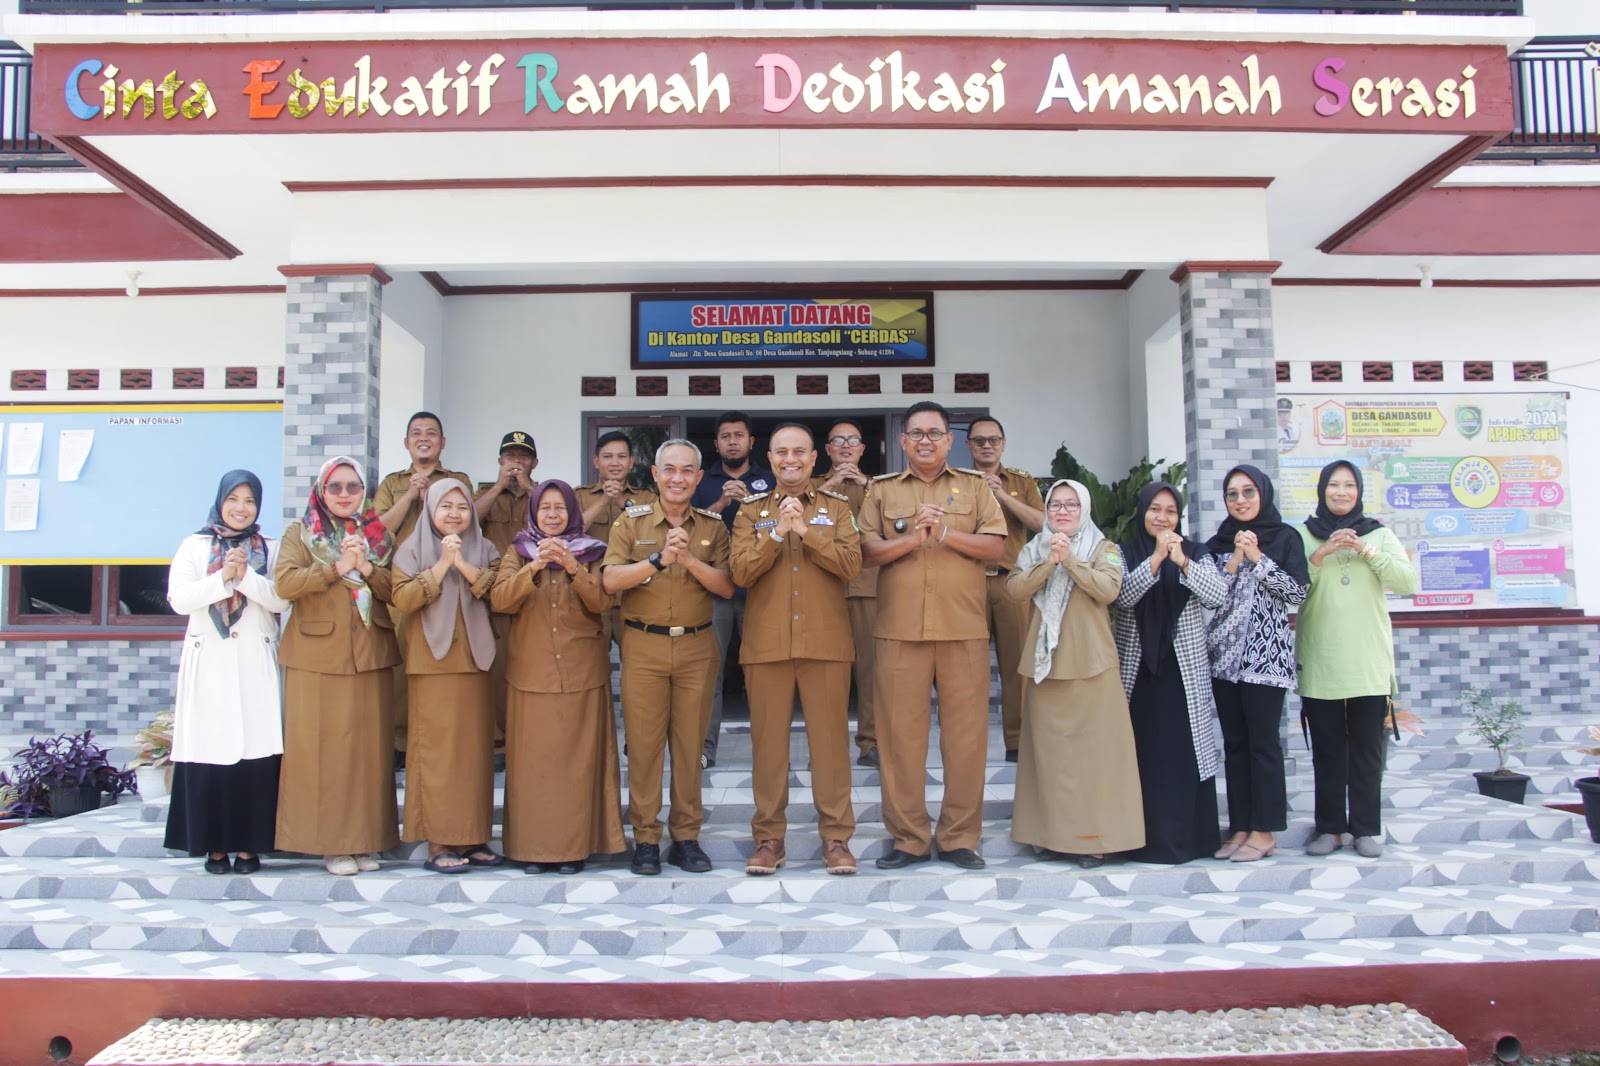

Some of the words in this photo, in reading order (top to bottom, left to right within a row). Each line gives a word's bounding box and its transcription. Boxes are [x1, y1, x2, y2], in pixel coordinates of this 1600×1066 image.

[64, 58, 218, 120] Cinta
[241, 53, 506, 119] Edukatif
[516, 52, 731, 115] Ramah
[755, 50, 1007, 114] Dedikasi
[1035, 53, 1282, 116] Amanah
[1313, 56, 1478, 119] Serasi
[691, 304, 787, 327] SELAMAT
[790, 303, 871, 327] DATANG
[648, 331, 665, 346] Di
[667, 330, 718, 346] Kantor
[722, 330, 760, 345] Desa
[763, 329, 841, 344] Gandasoli
[718, 349, 745, 357] Gandasoli
[817, 348, 854, 357] Tanjungsiang
[857, 349, 877, 357] Subang
[109, 417, 134, 425] PAPAN
[138, 417, 182, 425] INFORMASI
[1352, 411, 1376, 421] DESA
[1378, 411, 1432, 421] GANDASOLI
[1525, 410, 1557, 426] 2024
[1488, 426, 1531, 442] APBDes
[1532, 425, 1560, 441] awal
[1454, 460, 1481, 487] BELANJA
[1482, 464, 1497, 487] DESA
